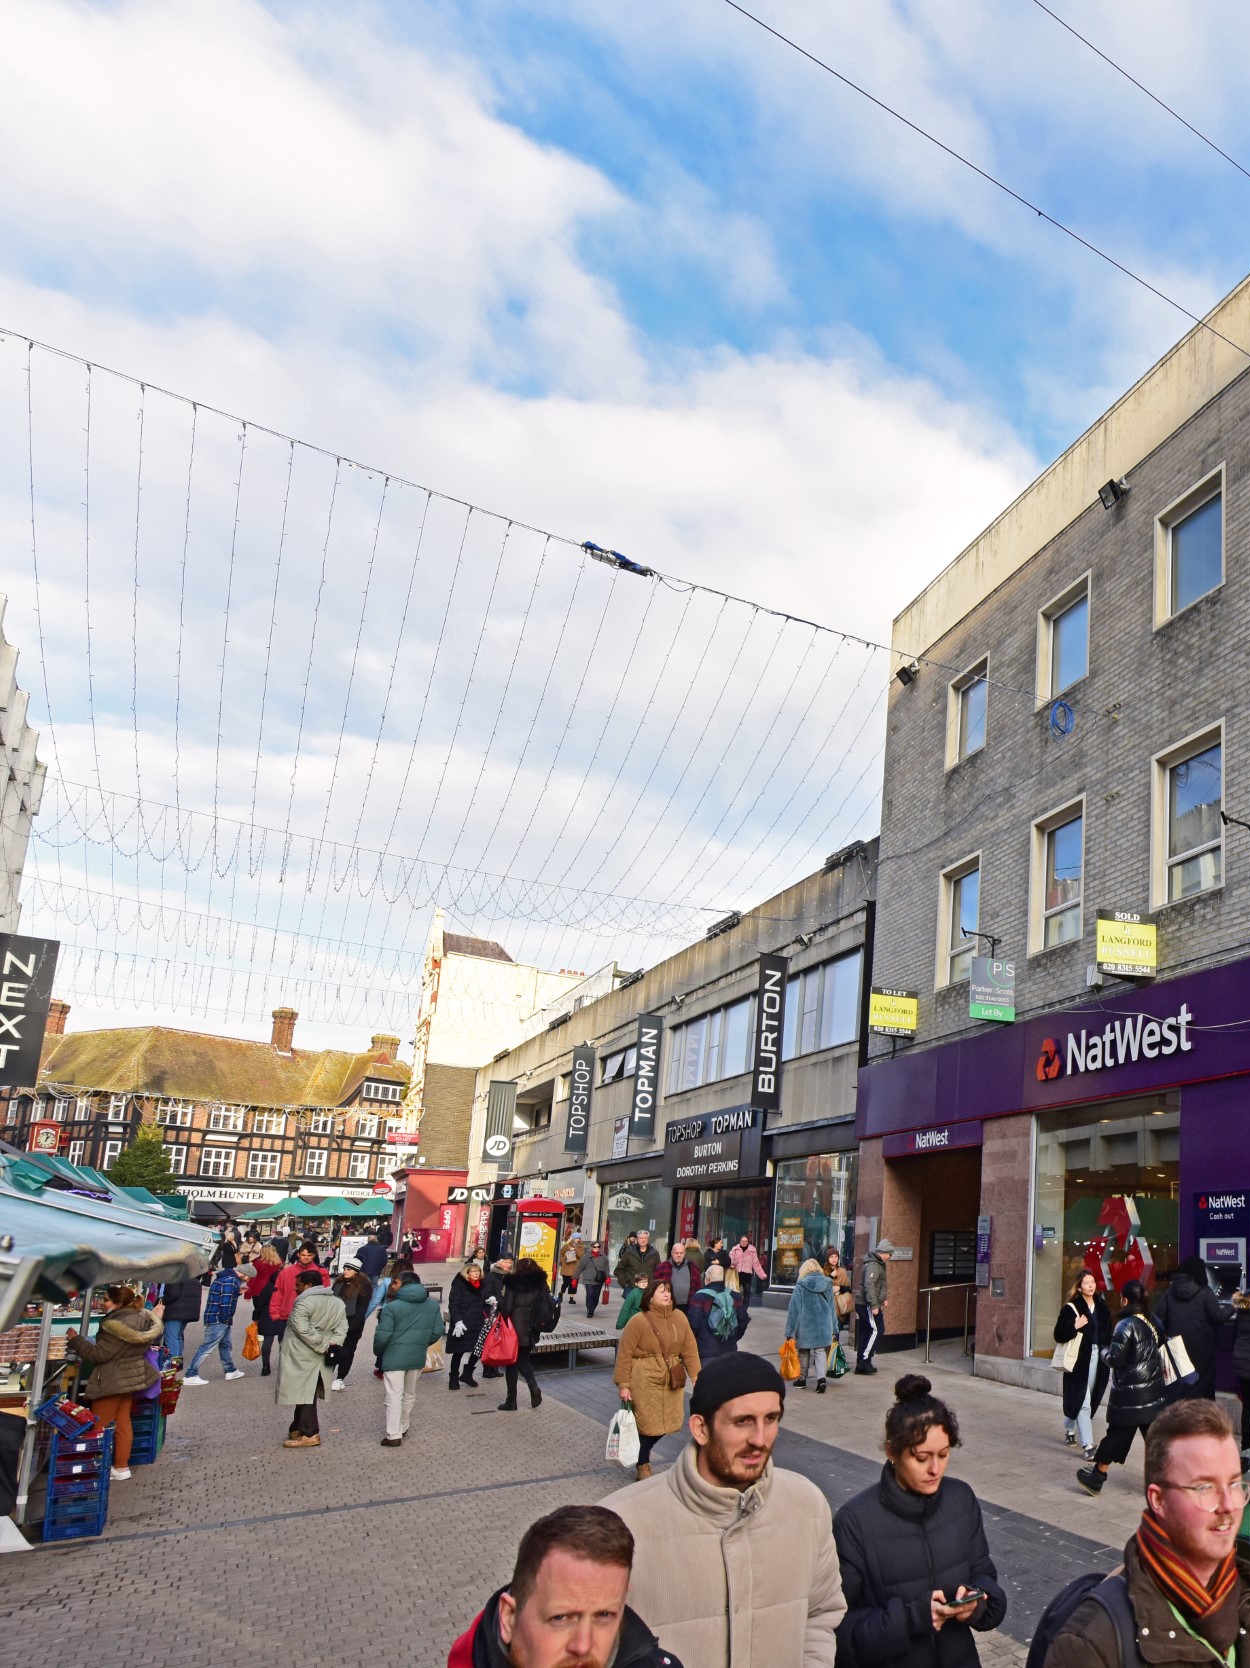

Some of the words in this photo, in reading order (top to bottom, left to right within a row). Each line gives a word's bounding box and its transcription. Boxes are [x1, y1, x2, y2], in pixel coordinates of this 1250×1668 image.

[1115, 911, 1141, 921] SOLD
[1101, 934, 1153, 947] LANGFORD
[1101, 945, 1152, 959] RUSSELL
[1102, 962, 1116, 971] 020
[1117, 963, 1133, 972] 8315
[1134, 965, 1151, 974] 5544
[971, 984, 993, 993] Parker
[995, 987, 1014, 996] Scott
[0, 950, 36, 1069] NEXT
[873, 1005, 914, 1016] LANGFORD
[981, 1007, 993, 1016] Let
[993, 1008, 1004, 1018] By
[757, 969, 782, 1094] BURTON
[1066, 1002, 1193, 1076] NatWest
[634, 1028, 658, 1122] TOPMAN
[569, 1059, 591, 1138] TOPSHOP
[667, 1120, 703, 1143] TOPSHOP
[711, 1109, 752, 1135] TOPMAN
[489, 1140, 507, 1151] JD
[915, 1129, 949, 1150] NatWest
[693, 1141, 722, 1159] BURTON
[676, 1164, 708, 1178] DOROTHY
[708, 1159, 739, 1174] PERKINS
[218, 1190, 265, 1200] HUNTER
[448, 1187, 468, 1201] JD
[1208, 1194, 1246, 1209] NatWest
[1209, 1212, 1224, 1220] Cash
[1224, 1212, 1235, 1220] out
[1215, 1247, 1235, 1256] NatWest
